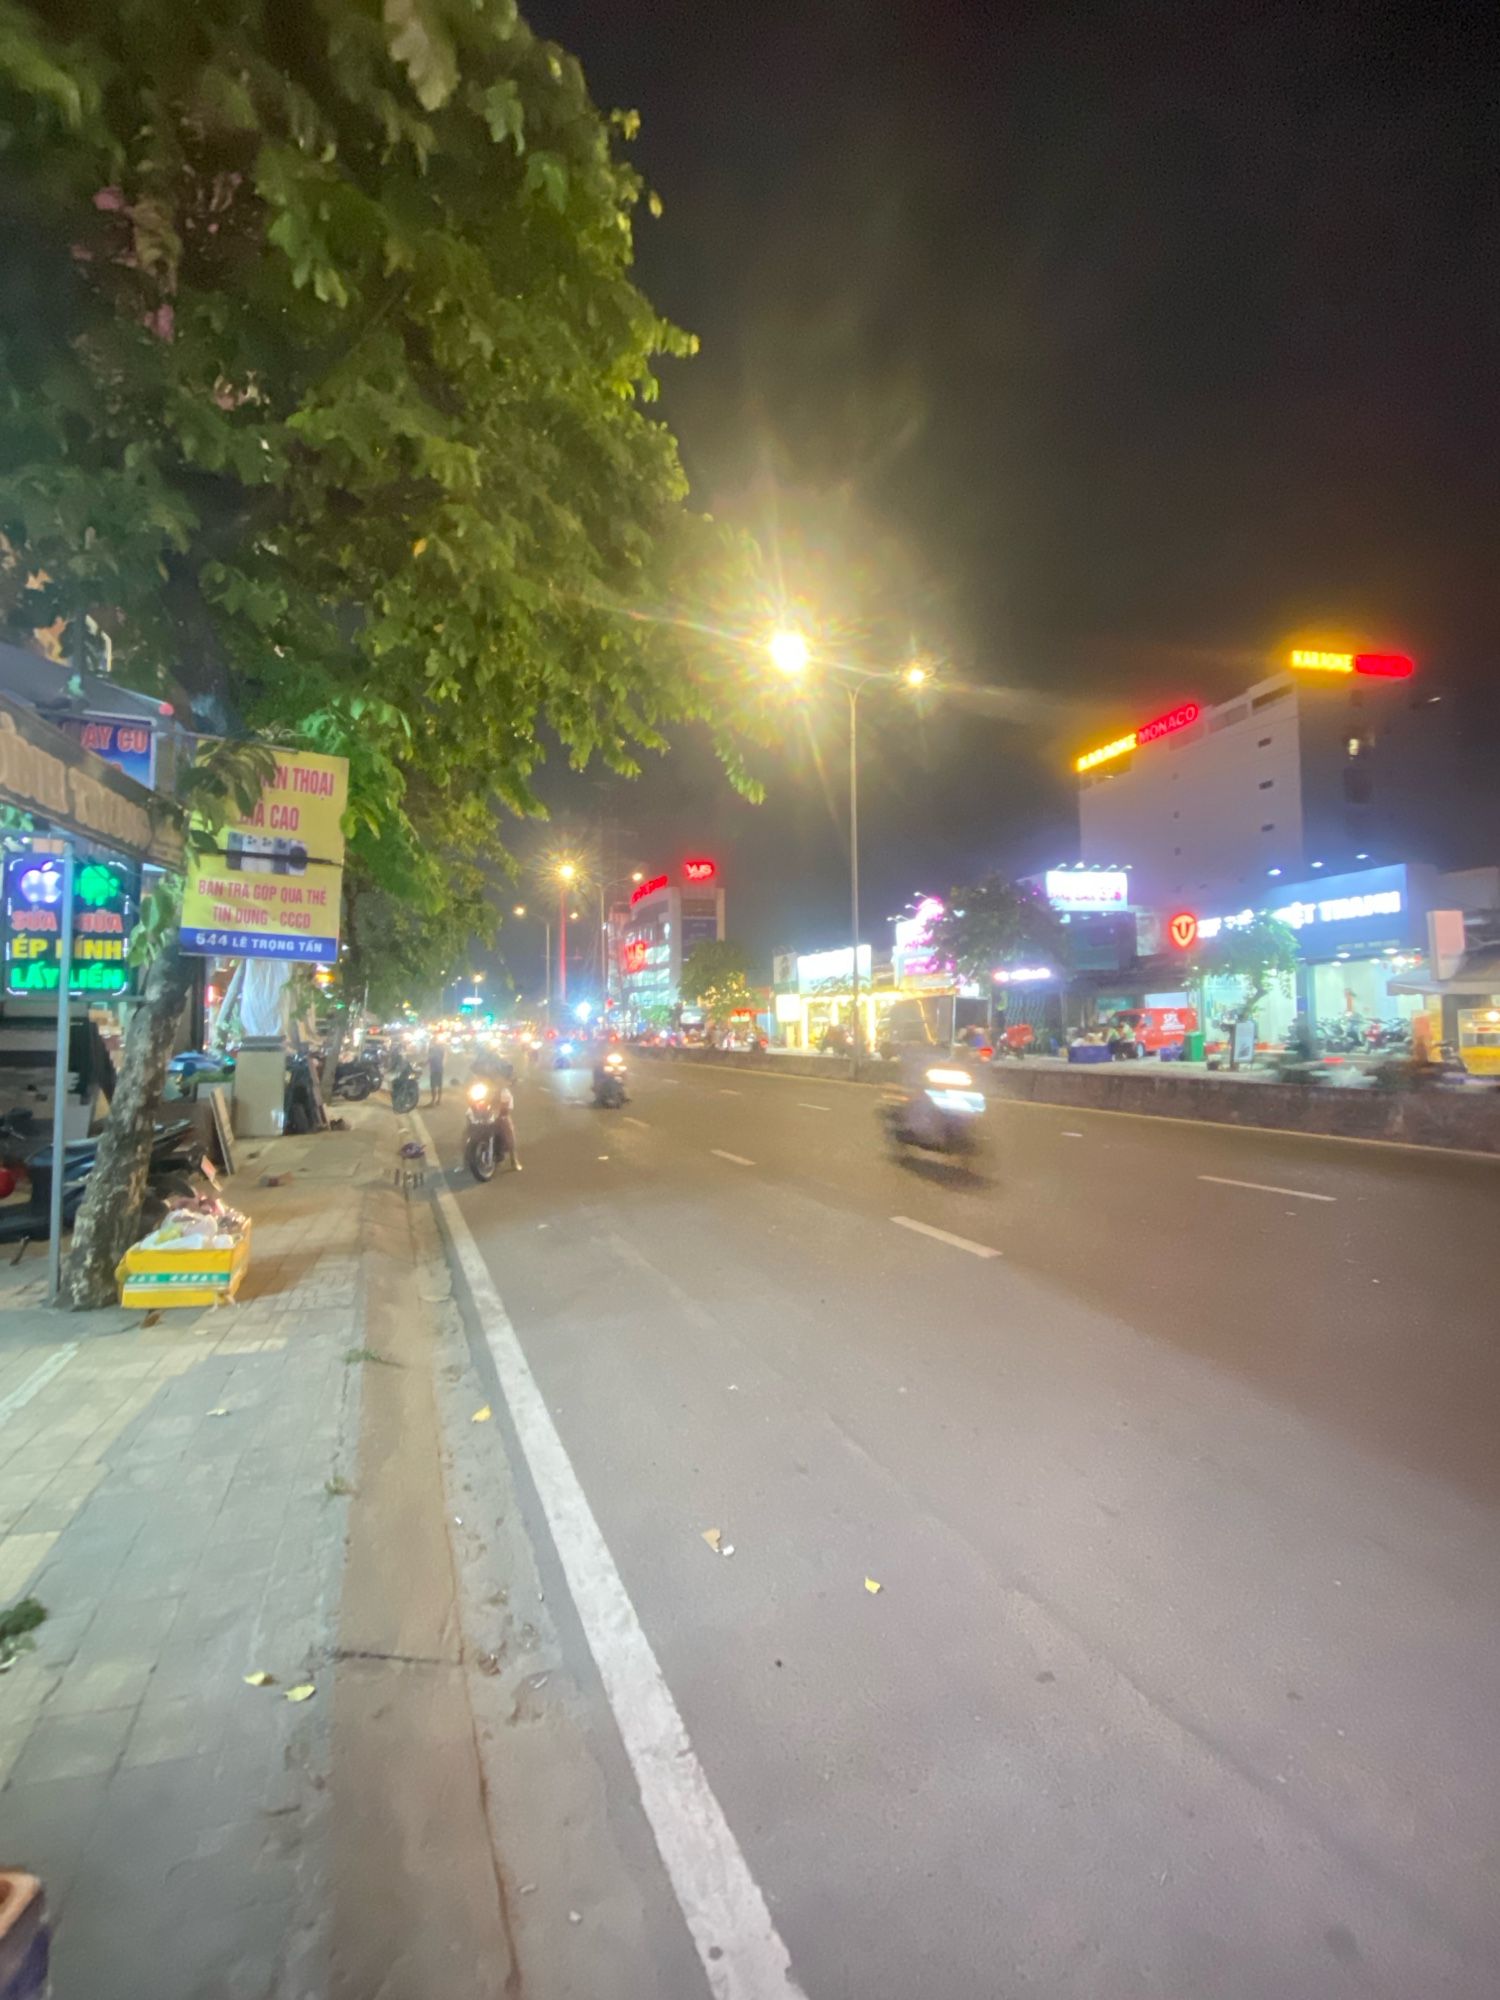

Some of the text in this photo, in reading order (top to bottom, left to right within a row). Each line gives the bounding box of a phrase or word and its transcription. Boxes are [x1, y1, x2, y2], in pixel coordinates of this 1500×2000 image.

[1138, 706, 1196, 743] MONACO
[270, 804, 299, 831] CAO
[12, 933, 48, 958] ÉP
[252, 939, 295, 952] TRỌNG
